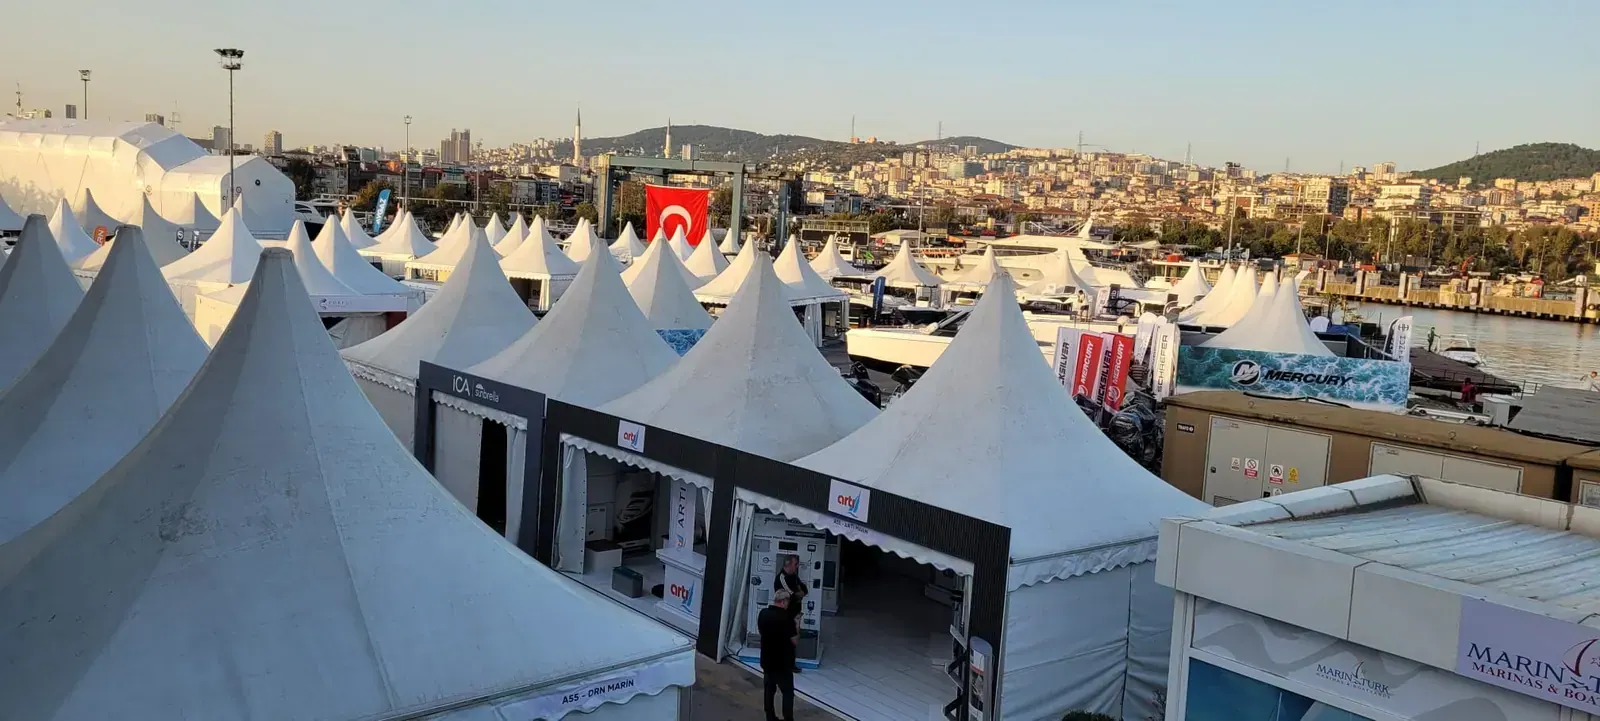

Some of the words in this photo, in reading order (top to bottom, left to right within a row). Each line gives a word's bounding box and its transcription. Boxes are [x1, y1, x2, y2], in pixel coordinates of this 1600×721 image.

[1081, 340, 1095, 384] MERCURY
[1096, 349, 1112, 407] UICKSILVER
[1113, 340, 1126, 385] MERCURY
[1157, 334, 1169, 393] SCHAEFER
[1263, 368, 1353, 387] MERCURY
[1316, 663, 1352, 682] MARIN
[1360, 677, 1391, 695] TURK
[1466, 642, 1566, 683] MARIN
[1472, 661, 1544, 690] MARINAS
[1547, 683, 1559, 695] &
[587, 685, 606, 698] DRN
